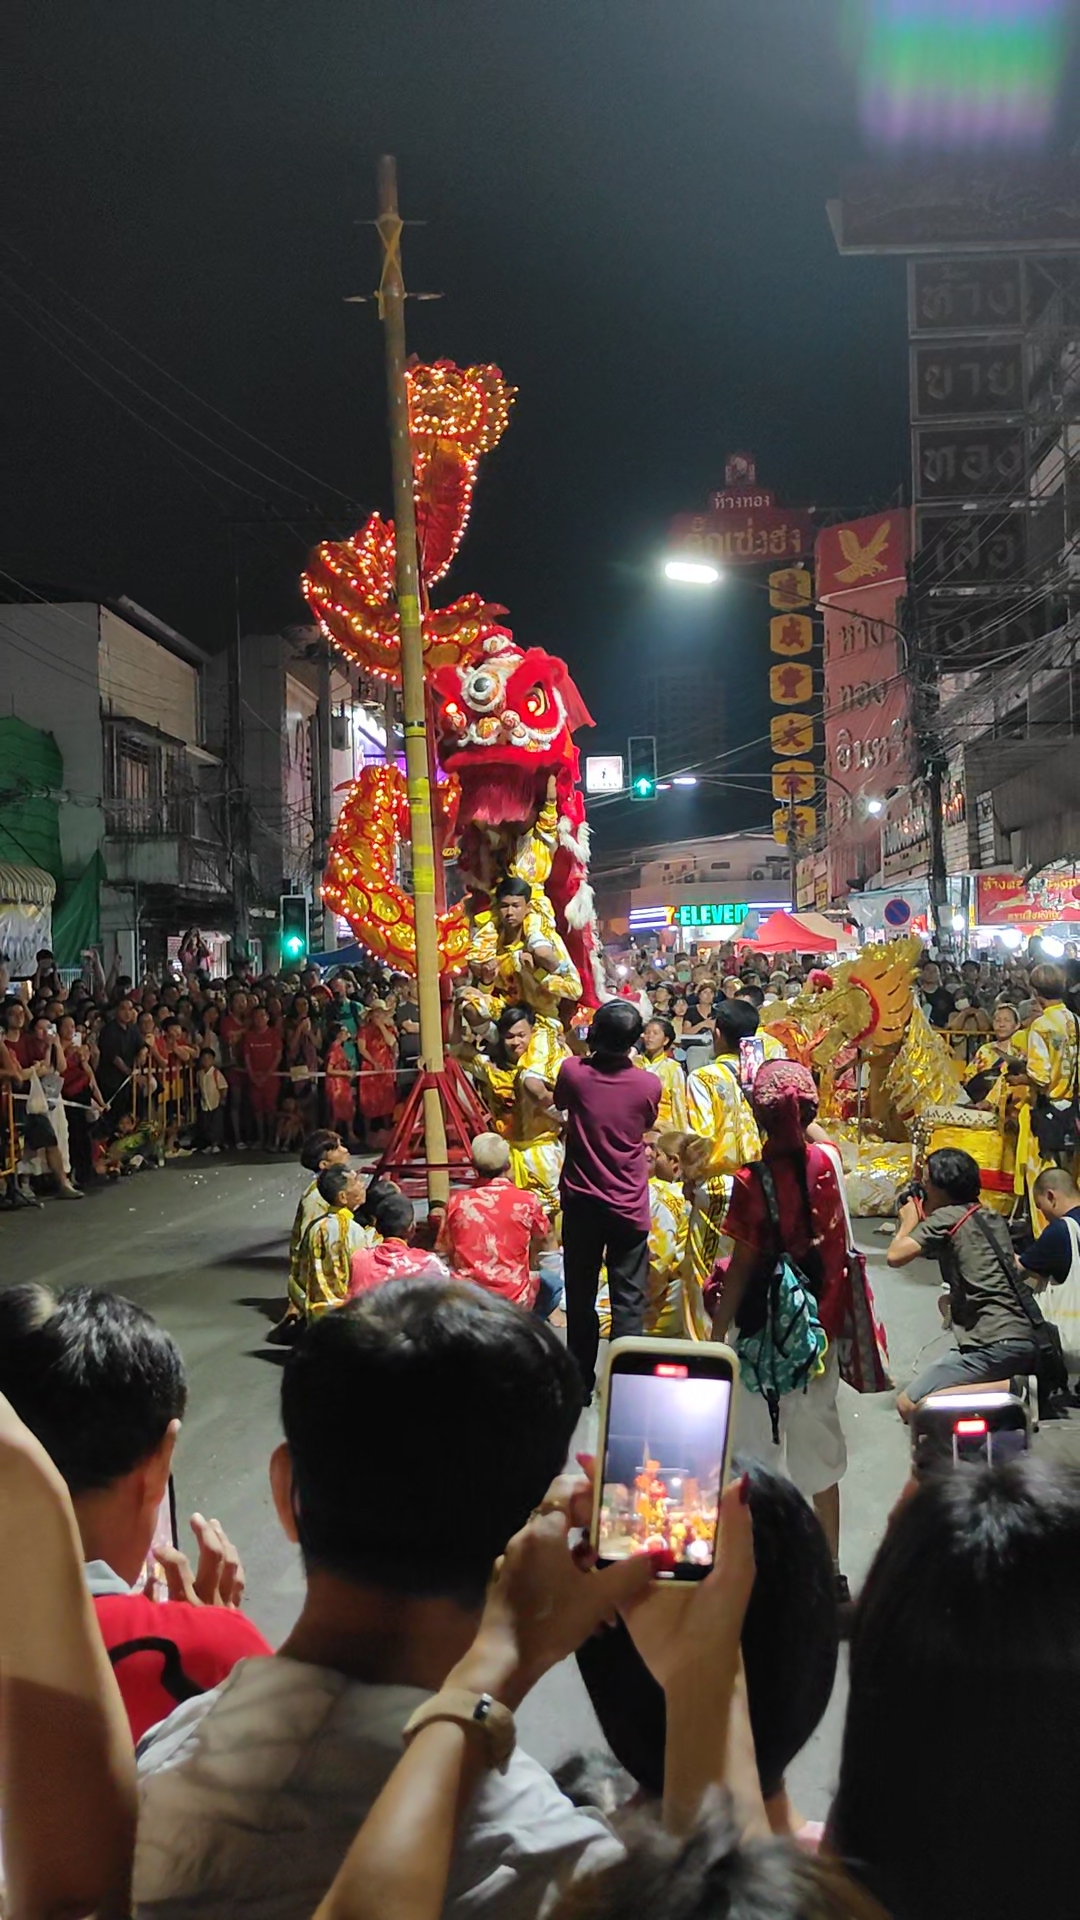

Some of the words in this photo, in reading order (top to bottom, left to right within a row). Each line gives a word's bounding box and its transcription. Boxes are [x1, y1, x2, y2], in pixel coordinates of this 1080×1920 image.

[924, 359, 1016, 400] ขาย
[923, 444, 1023, 483] ทอง
[714, 490, 770, 510] ห้างทอง
